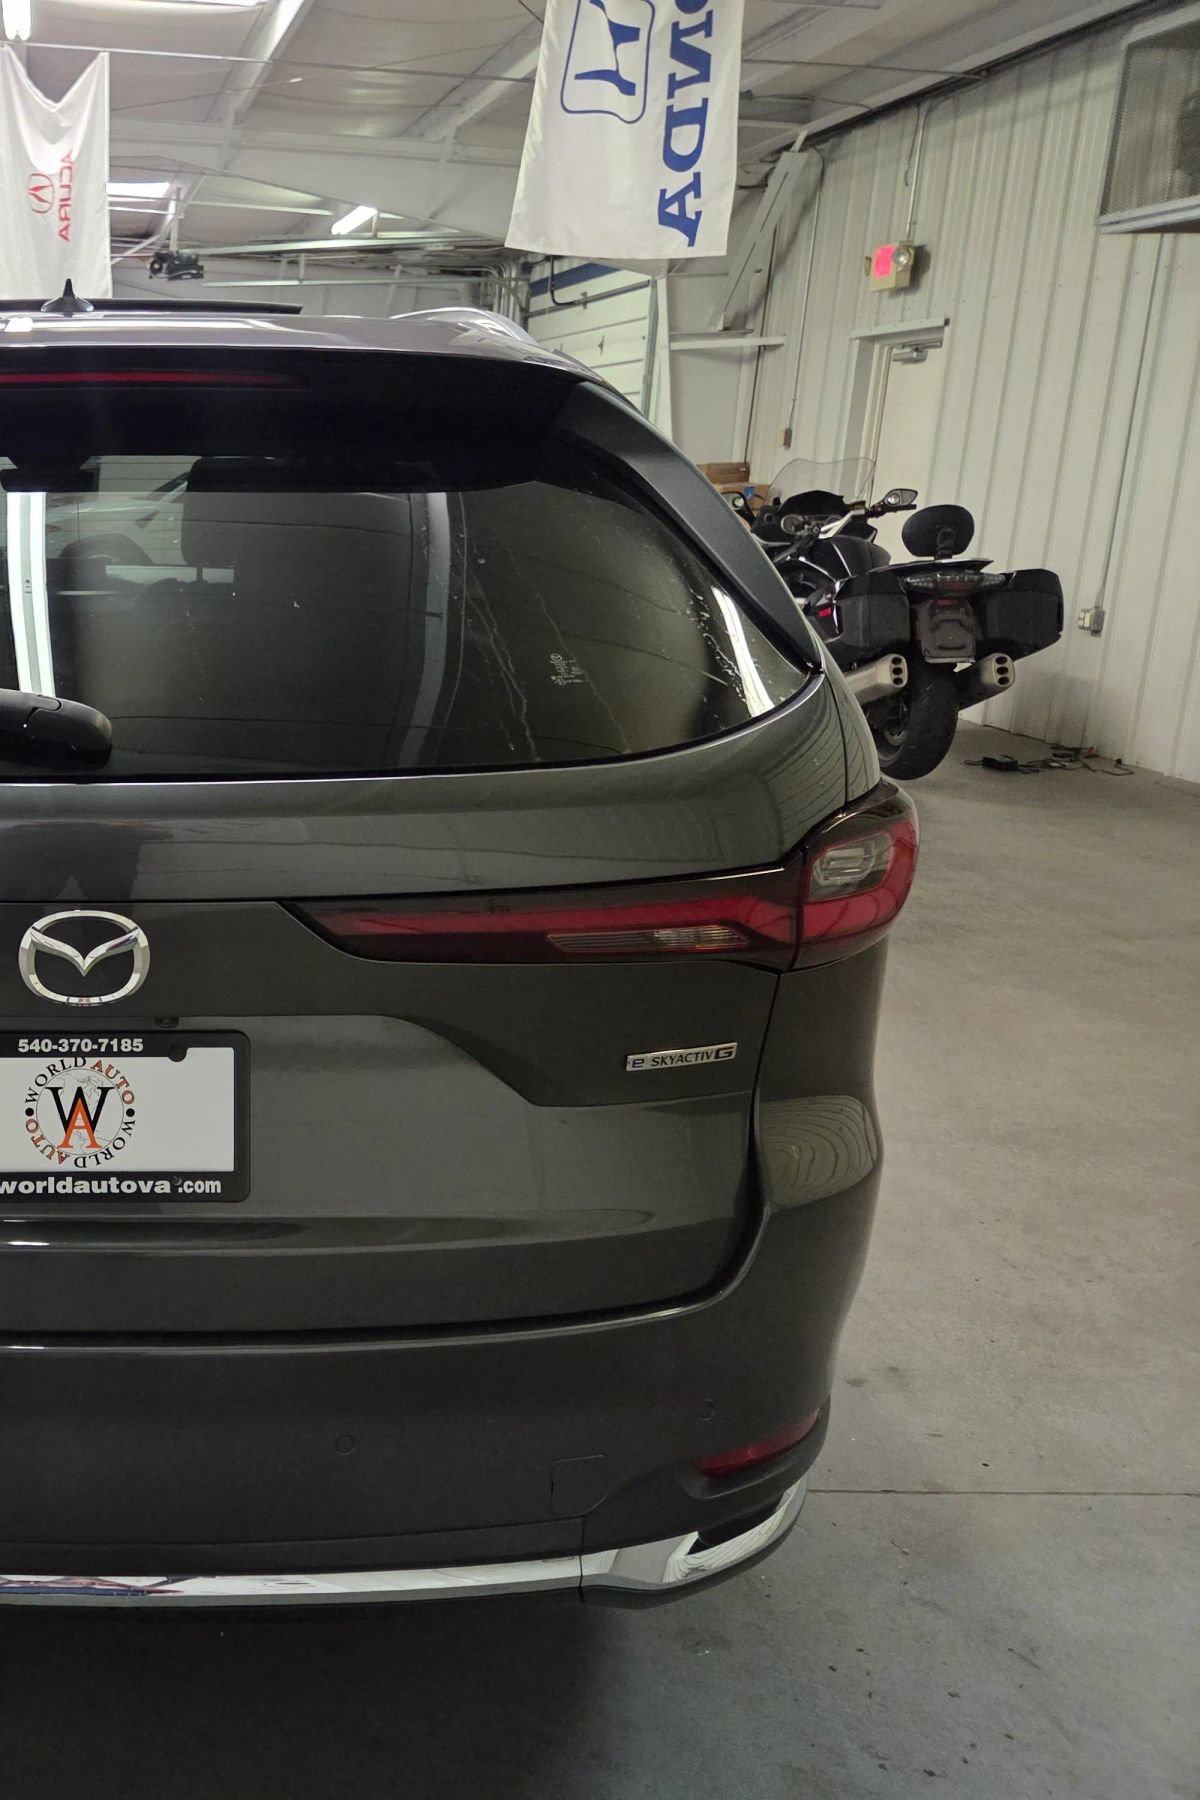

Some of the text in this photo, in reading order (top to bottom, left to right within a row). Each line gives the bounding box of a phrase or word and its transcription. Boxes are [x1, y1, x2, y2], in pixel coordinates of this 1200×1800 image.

[17, 1038, 144, 1053] 540-370-7185
[650, 1050, 714, 1067] SKYACTIV
[25, 1056, 135, 1105] WORLD AUTO
[25, 1118, 136, 1169] WORLD AUTO
